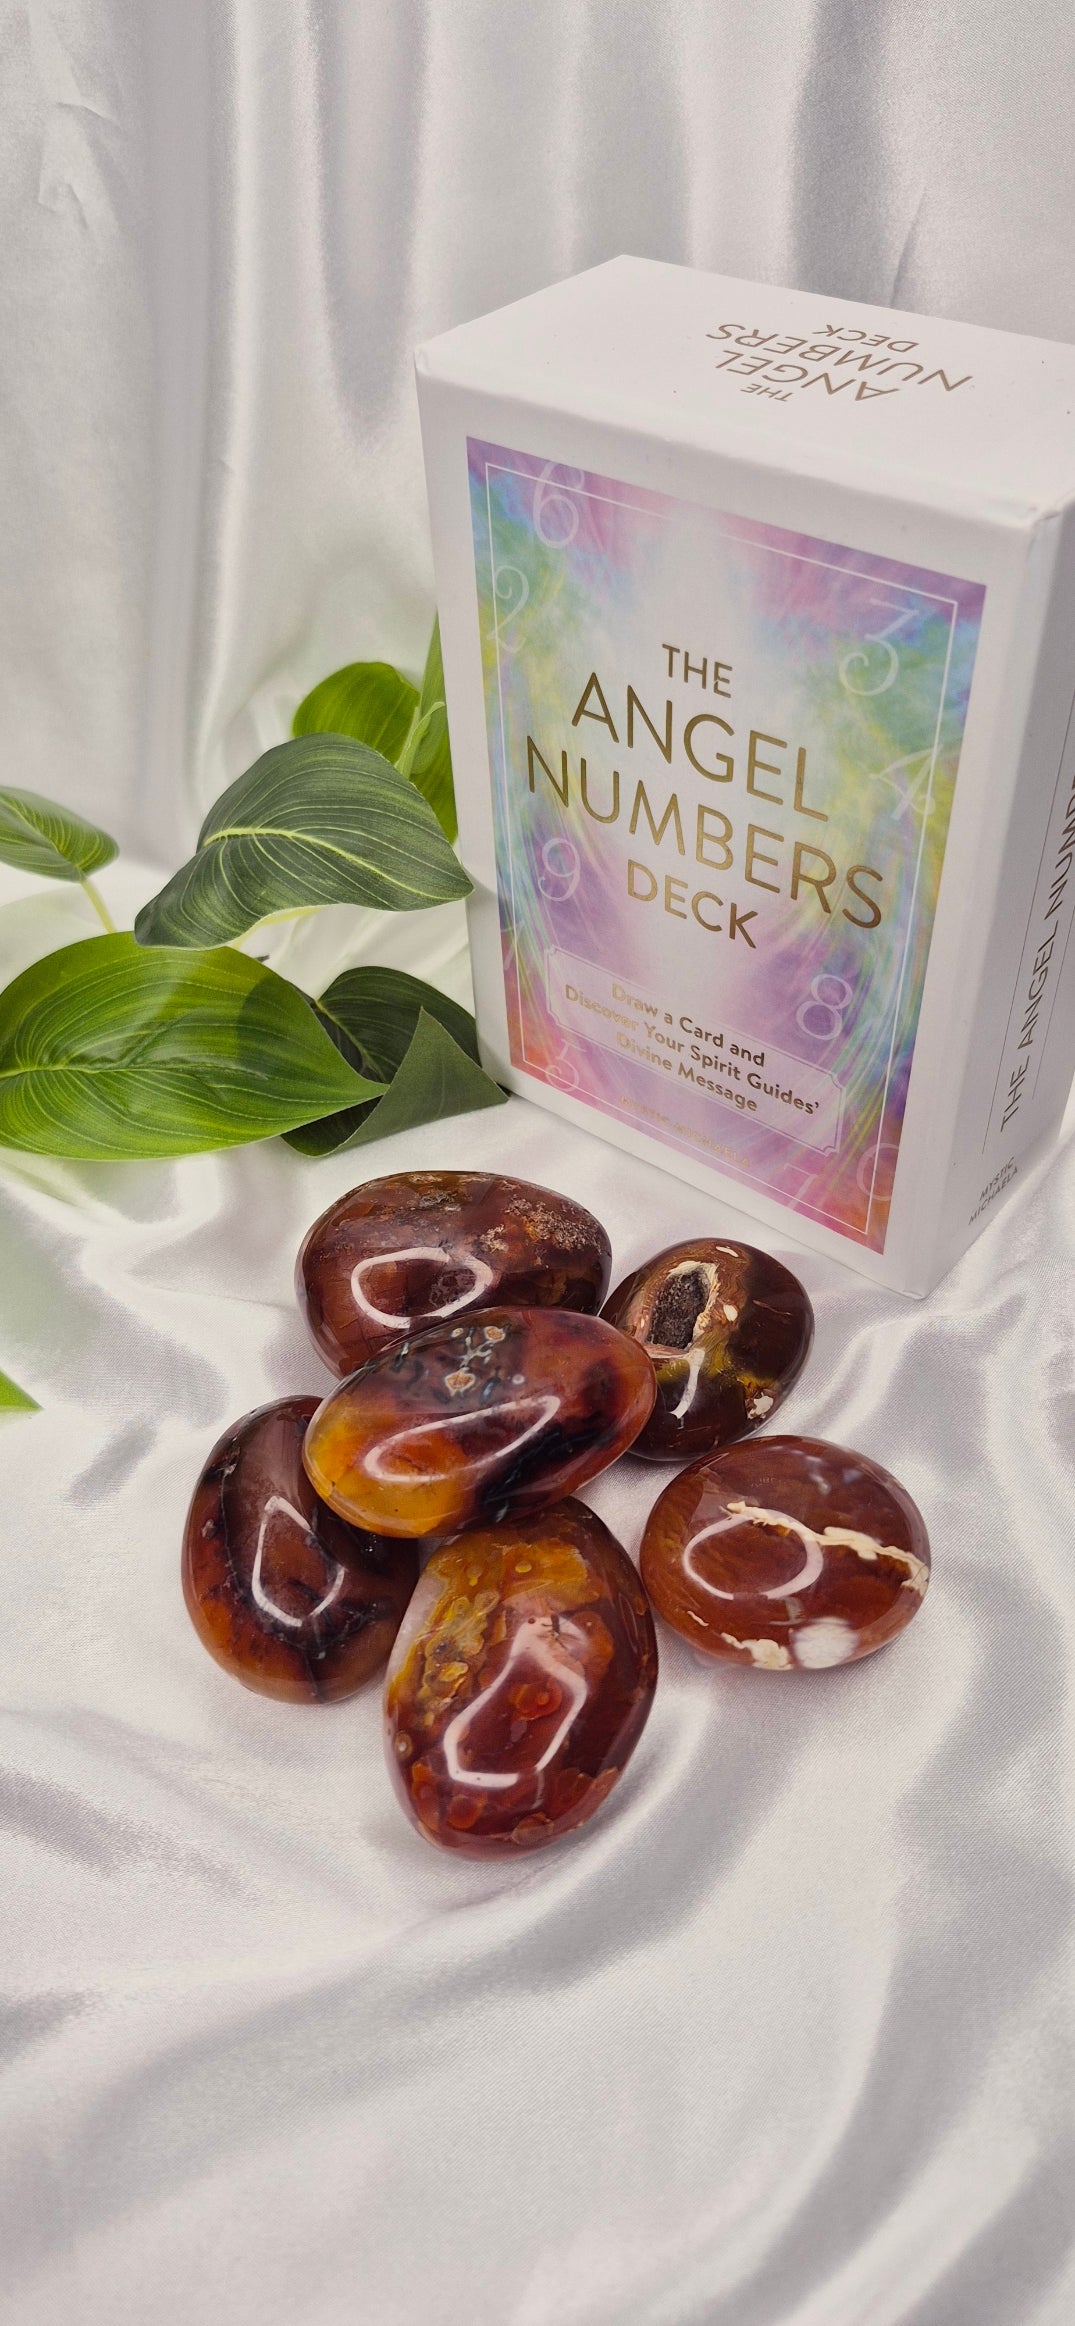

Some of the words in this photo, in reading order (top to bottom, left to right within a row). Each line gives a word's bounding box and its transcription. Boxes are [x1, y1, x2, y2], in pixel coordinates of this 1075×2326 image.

[705, 324, 973, 392] NUMBERS
[715, 350, 899, 401] ANGEL
[812, 324, 919, 353] DECK
[740, 383, 793, 401] THE
[533, 461, 585, 549] 6
[486, 565, 530, 653] 2
[839, 597, 920, 696] 3
[662, 643, 733, 699] THE
[571, 671, 829, 822] ANGEL
[869, 744, 944, 821] 4
[527, 735, 884, 929] NUMBERS
[537, 837, 581, 901] 9
[627, 858, 759, 950] DECK
[611, 982, 659, 1018] Draw
[664, 1010, 673, 1025] a
[679, 1016, 725, 1049] Card
[730, 1042, 766, 1068] and
[795, 973, 853, 1041] 8
[1000, 1055, 1030, 1133] THE
[1017, 919, 1059, 1050] ANGEL
[545, 1037, 588, 1092] 5
[565, 983, 639, 1032] Discover
[644, 1020, 686, 1053] Your
[690, 1044, 742, 1081] Spirit
[747, 1071, 820, 1115] Guides’
[616, 1030, 673, 1071] Divine
[678, 1062, 759, 1112] Message
[968, 1166, 1018, 1226] MICHAELA
[979, 1156, 1015, 1201] MYSTIC
